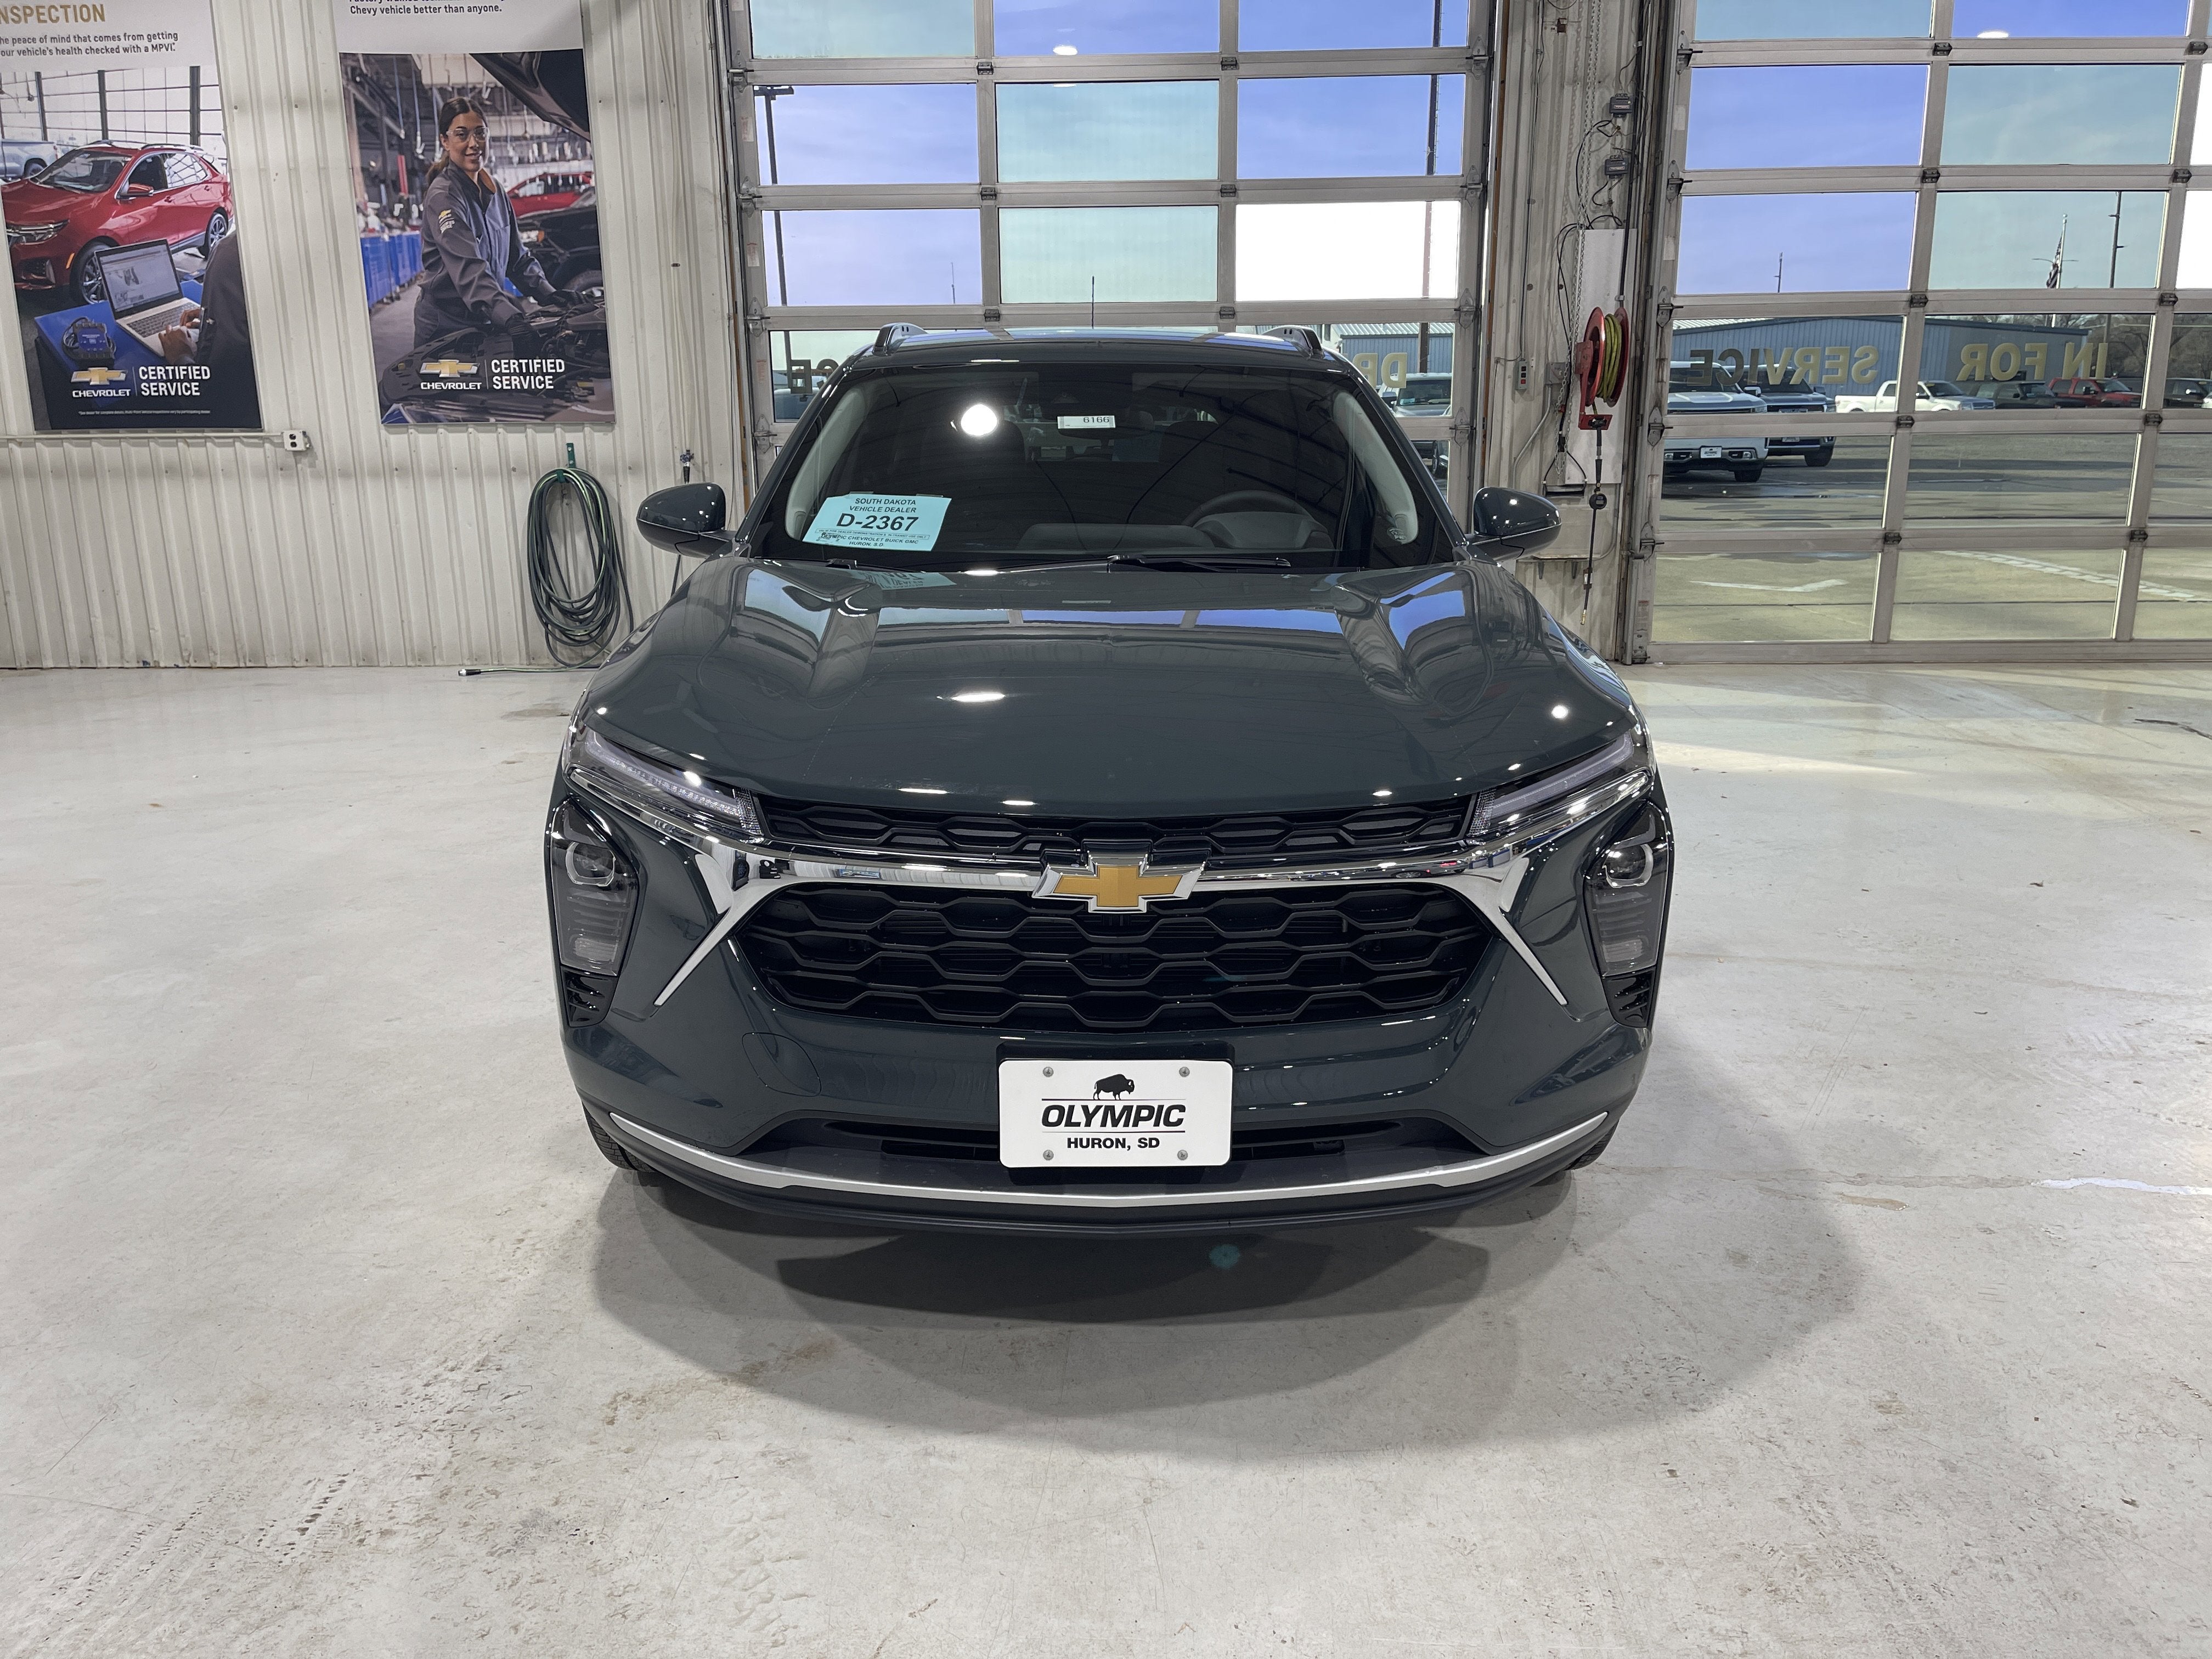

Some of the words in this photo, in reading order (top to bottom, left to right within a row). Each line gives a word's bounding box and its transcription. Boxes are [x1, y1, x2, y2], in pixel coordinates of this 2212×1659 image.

[350, 5, 377, 16] Chevy
[380, 5, 411, 14] vehicle
[414, 5, 442, 14] better
[444, 4, 465, 13] than
[467, 4, 502, 15] anyone.
[12, 36, 37, 47] peace
[39, 35, 47, 43] of
[50, 34, 71, 43] mind
[73, 33, 92, 43] that
[123, 32, 144, 41] from
[146, 31, 178, 42] getting
[16, 47, 54, 56] vehicle's
[55, 46, 82, 55] health
[84, 45, 120, 54] checked
[122, 44, 142, 53] with
[138, 365, 211, 381] CERTIFIED
[491, 358, 566, 374] CERTIFIED
[140, 381, 201, 397] SERVICE
[420, 382, 482, 391] CHEVROLET
[493, 375, 554, 390] SERVICE
[72, 388, 131, 398] CHEVROLET
[836, 512, 919, 531] D-2367
[1041, 1104, 1187, 1128] OLYMPIC
[1066, 1137, 1131, 1151] HURON,
[1137, 1137, 1160, 1149] SD
